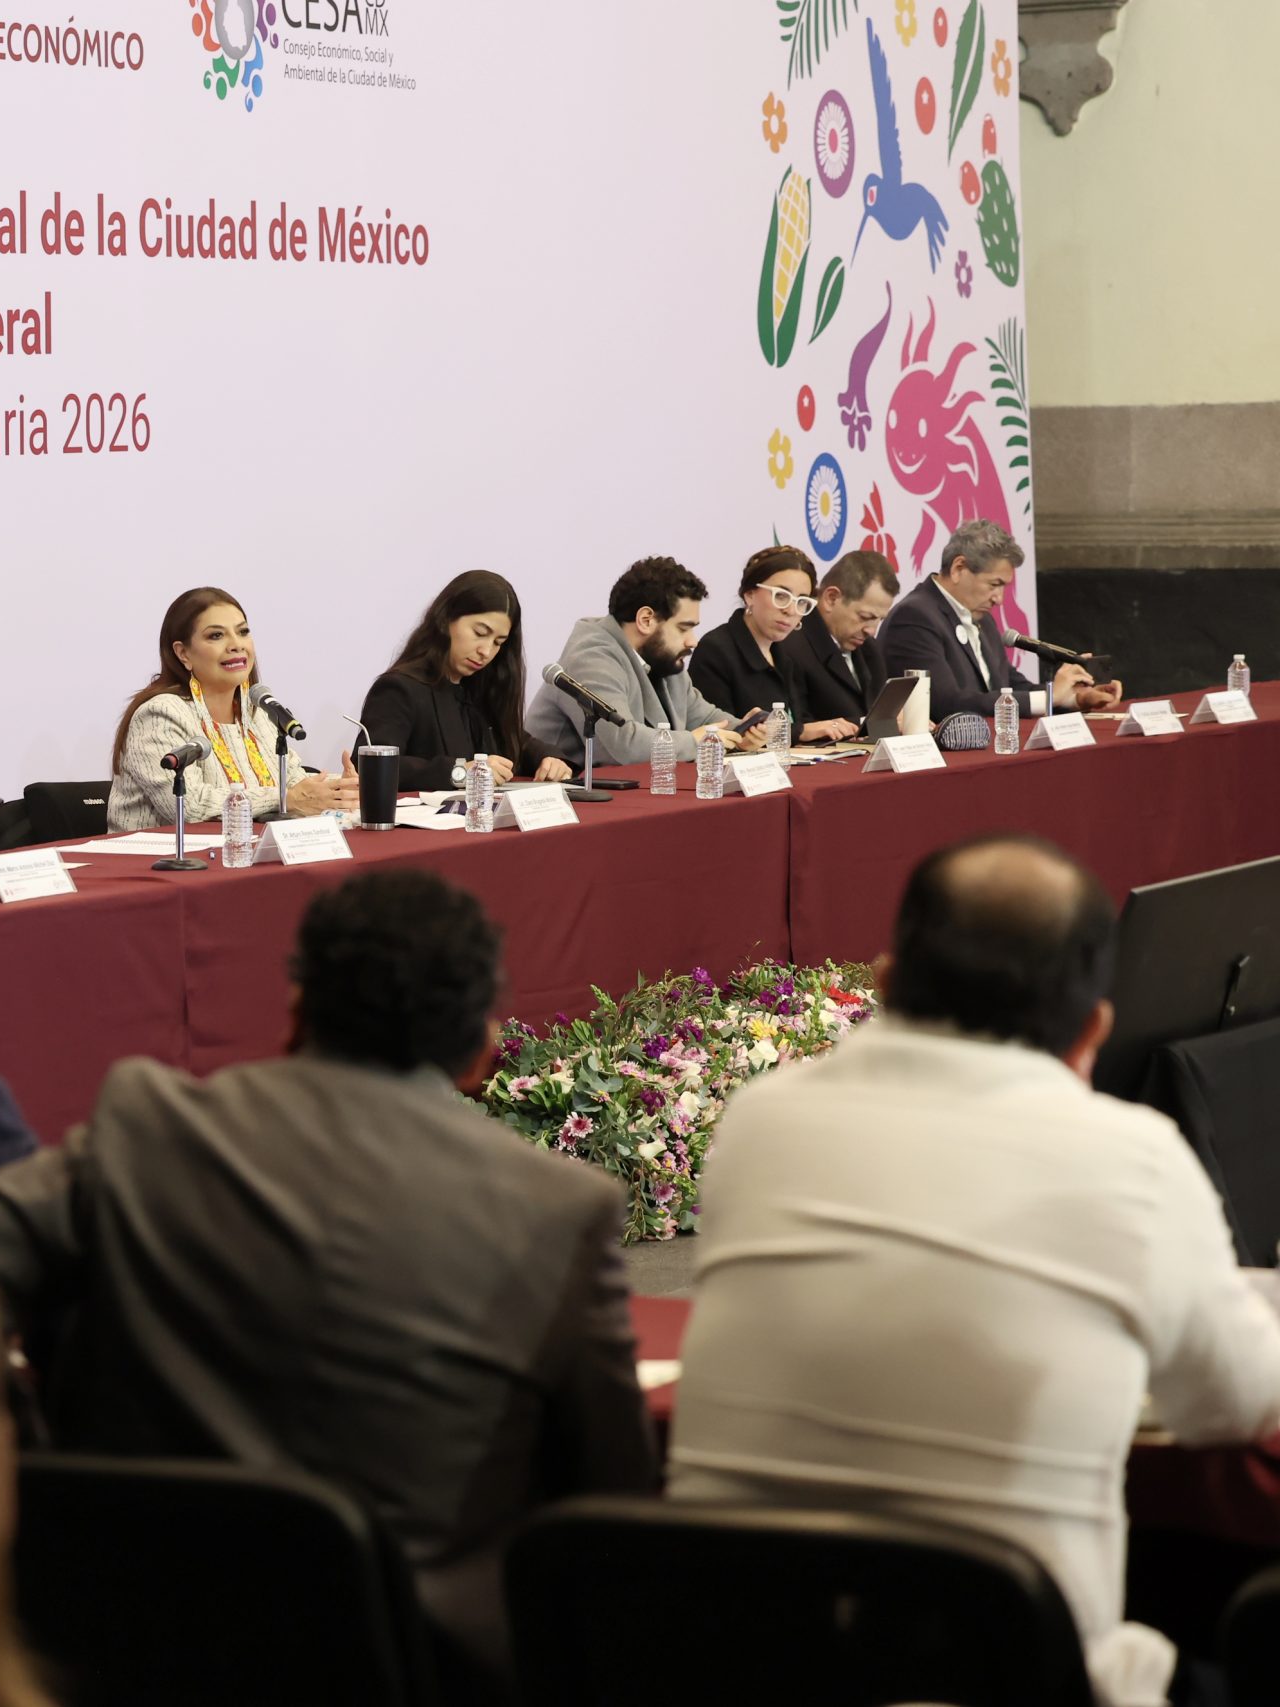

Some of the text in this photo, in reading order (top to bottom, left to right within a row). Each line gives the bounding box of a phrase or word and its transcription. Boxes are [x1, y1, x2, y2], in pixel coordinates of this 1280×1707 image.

[365, 8, 389, 36] MX
[283, 38, 394, 67] Consejo Económico, Social y
[284, 64, 416, 90] Ambiental de la Ciudad de México
[41, 192, 85, 256] de
[97, 193, 127, 256] la
[139, 197, 257, 260] Ciudad
[269, 202, 307, 262] de
[318, 205, 429, 266] México
[62, 392, 150, 454] 2026
